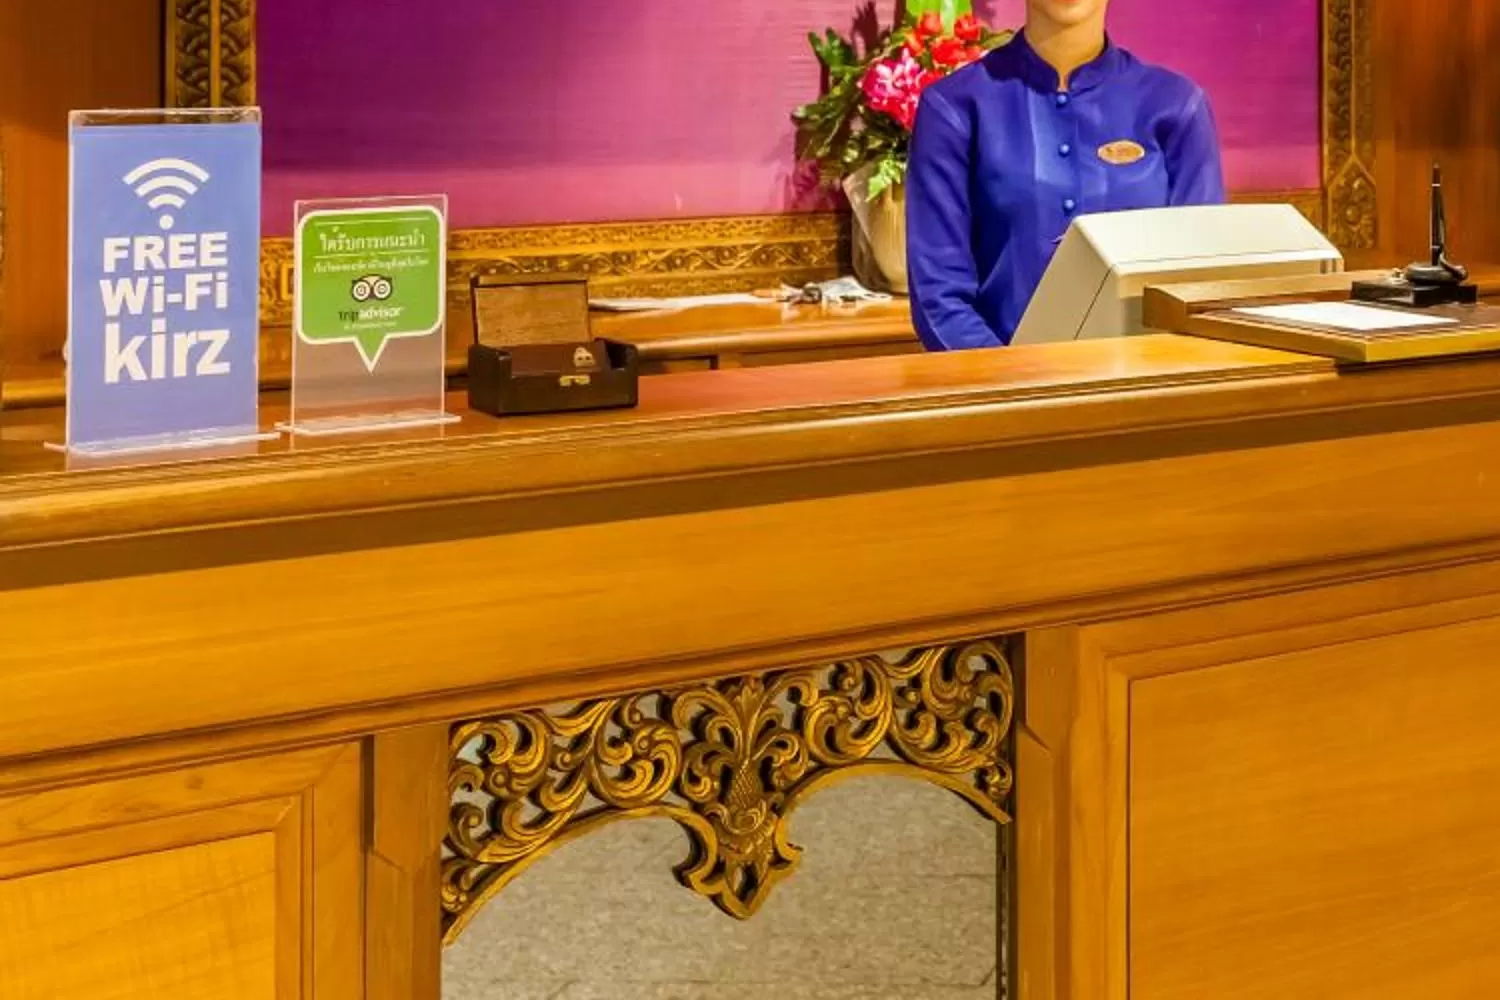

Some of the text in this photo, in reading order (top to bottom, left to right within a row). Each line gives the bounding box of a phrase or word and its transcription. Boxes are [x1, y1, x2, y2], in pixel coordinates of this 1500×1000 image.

[103, 232, 228, 272] FREE
[99, 272, 228, 317] Wi-Fi
[104, 317, 231, 384] kirz
